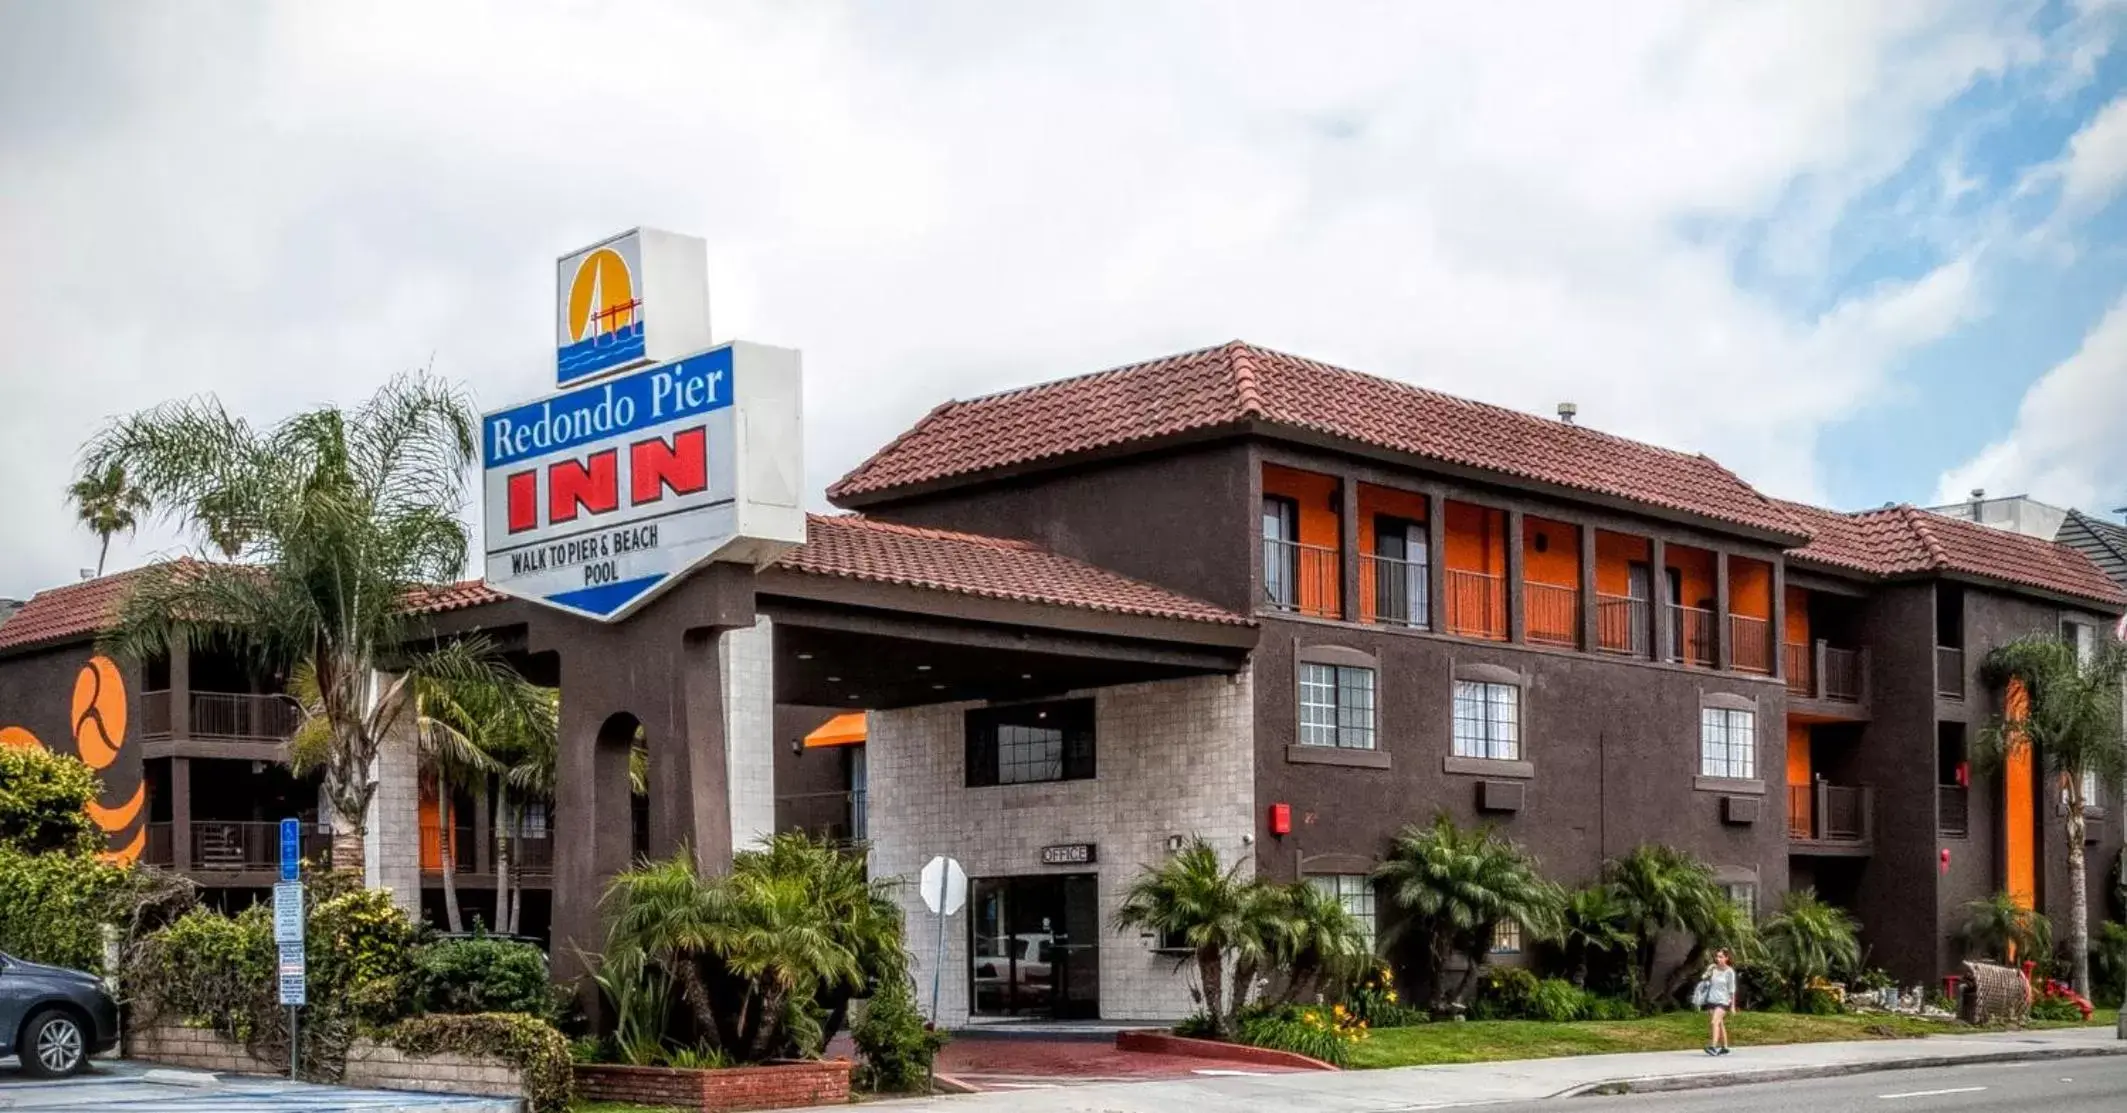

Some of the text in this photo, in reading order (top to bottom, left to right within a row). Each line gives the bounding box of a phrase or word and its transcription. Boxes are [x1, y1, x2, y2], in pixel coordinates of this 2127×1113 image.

[492, 364, 723, 460] Redondo Pier
[508, 425, 708, 535] INN
[512, 524, 658, 575] WALK TO PIER & BEACH
[585, 561, 619, 586] POOL
[1042, 846, 1086, 861] OFFICE
